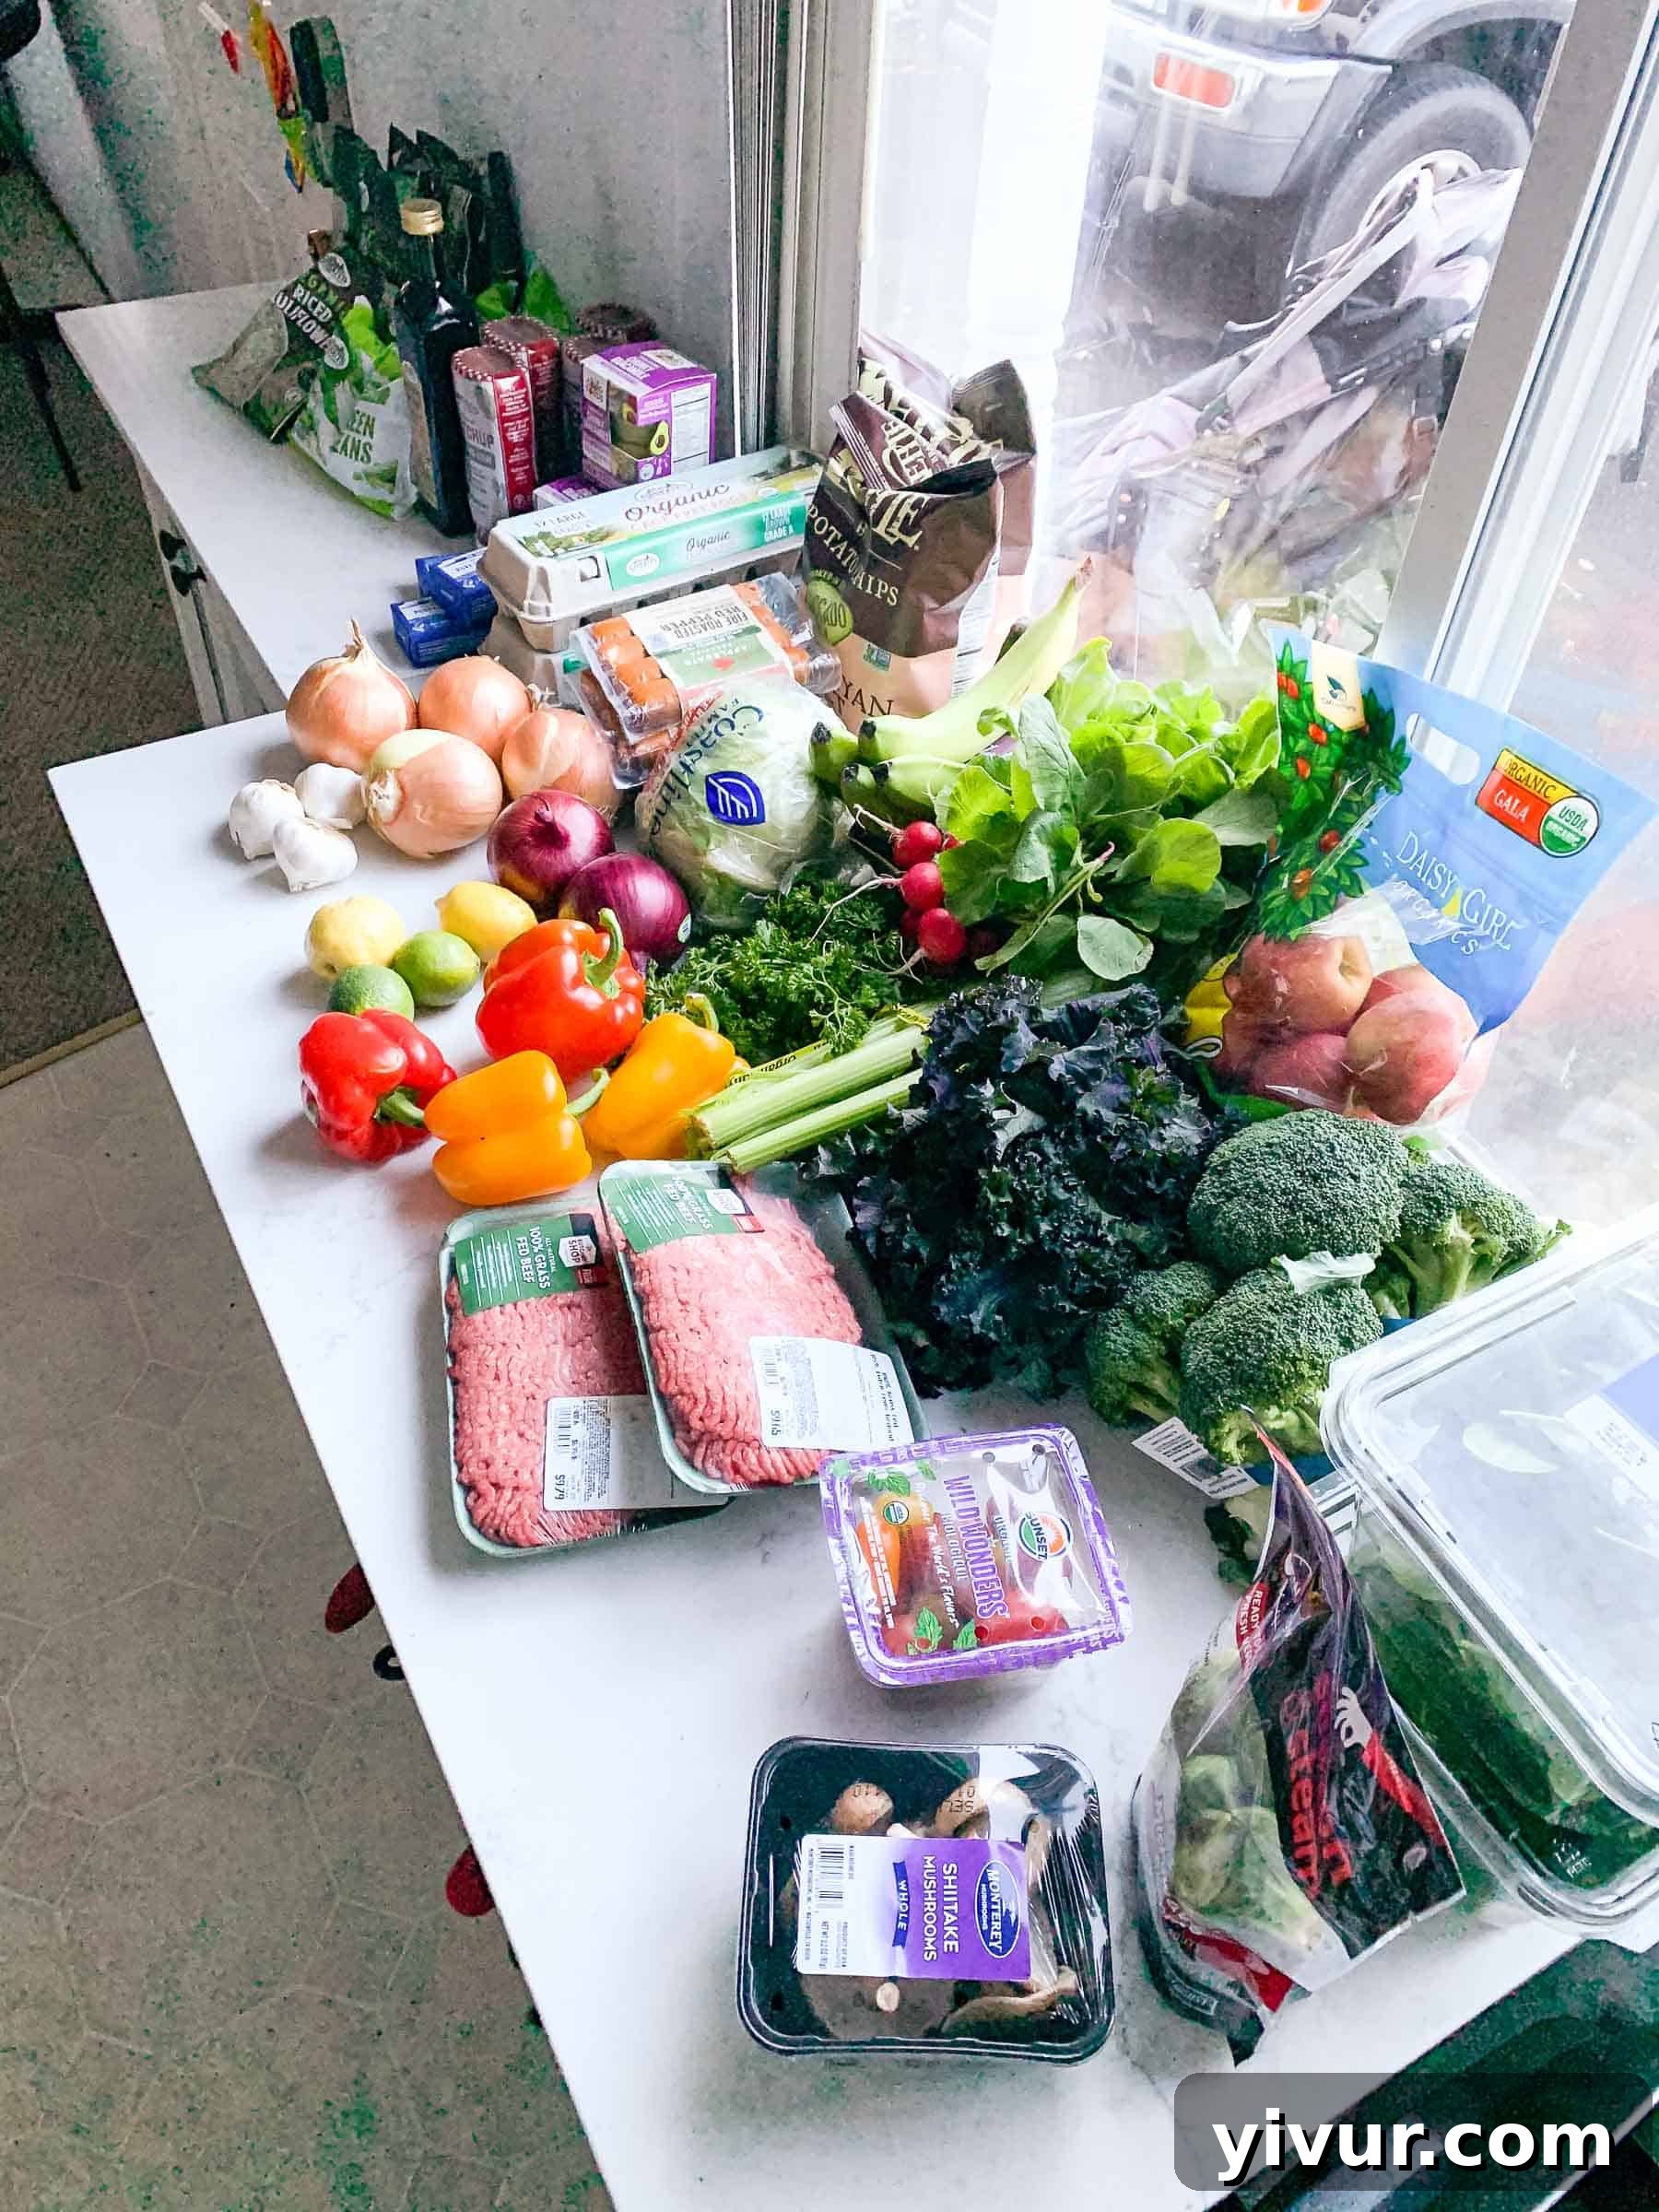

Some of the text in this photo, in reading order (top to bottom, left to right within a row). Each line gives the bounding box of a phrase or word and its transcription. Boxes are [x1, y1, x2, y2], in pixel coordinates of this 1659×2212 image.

[292, 284, 333, 323] RICED
[624, 484, 730, 523] Organic
[686, 530, 731, 552] Organic
[853, 567, 900, 606] HIPS
[673, 618, 724, 639] ROASTED
[1503, 759, 1557, 799] ORGANIC
[1494, 788, 1530, 823] GALA
[1558, 806, 1590, 831] USDA
[1395, 830, 1521, 952] DAISY GIRL
[516, 1237, 535, 1283] FED BEEF
[529, 1227, 549, 1288] 100% GRASS
[569, 1240, 581, 1263] SHOP
[925, 1524, 939, 1544] The
[943, 1474, 1008, 1620] WILD WONDERS
[1026, 1512, 1049, 1559] SUNSET
[931, 1543, 951, 1584] World's
[1252, 1590, 1262, 1629] READY
[898, 1879, 909, 1931] WHOLE
[924, 1856, 936, 1961] MUSHROOMS
[943, 1863, 959, 1952] SHIITAKE
[986, 1869, 1003, 1950] MONTEREY
